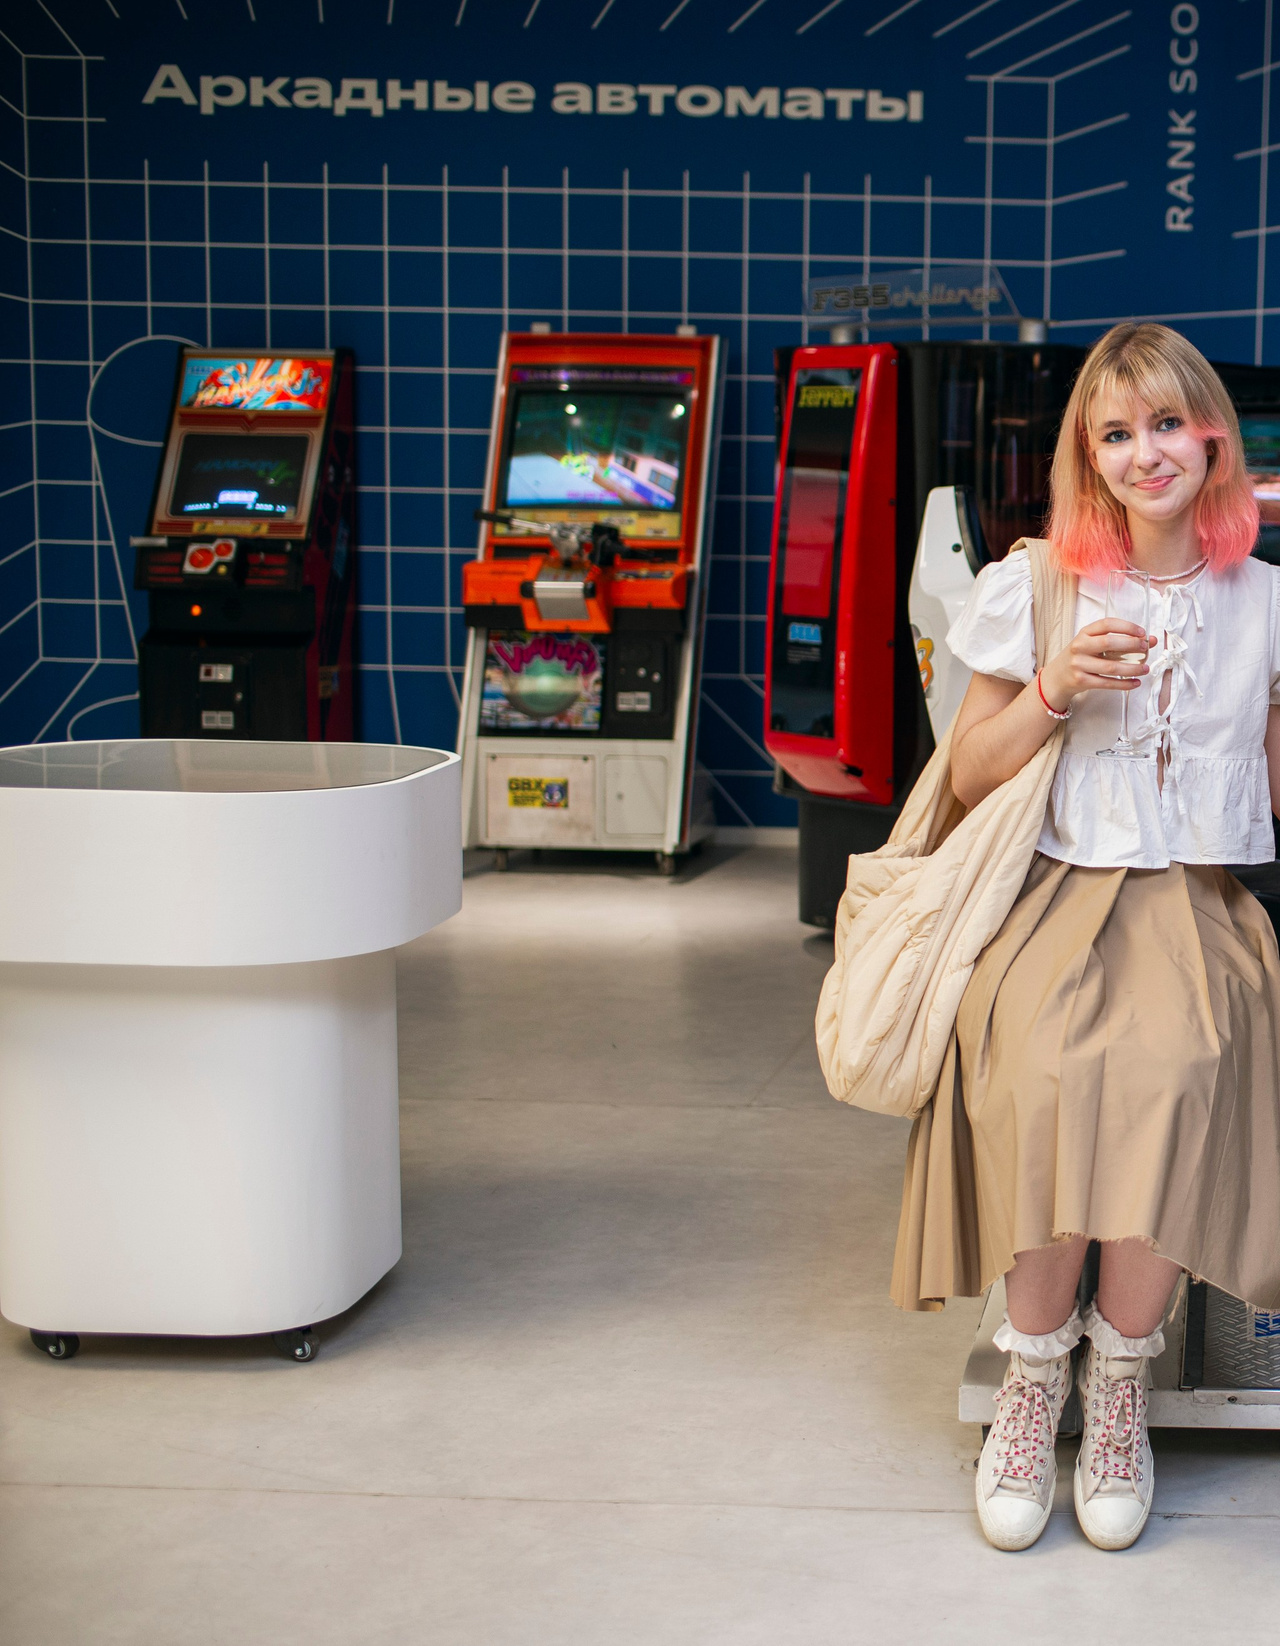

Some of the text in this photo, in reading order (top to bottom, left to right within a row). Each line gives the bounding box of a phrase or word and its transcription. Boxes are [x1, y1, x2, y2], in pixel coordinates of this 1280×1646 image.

[142, 64, 925, 123] Аркадные автоматы
[1165, 109, 1197, 232] RANK
[812, 283, 891, 312] F355
